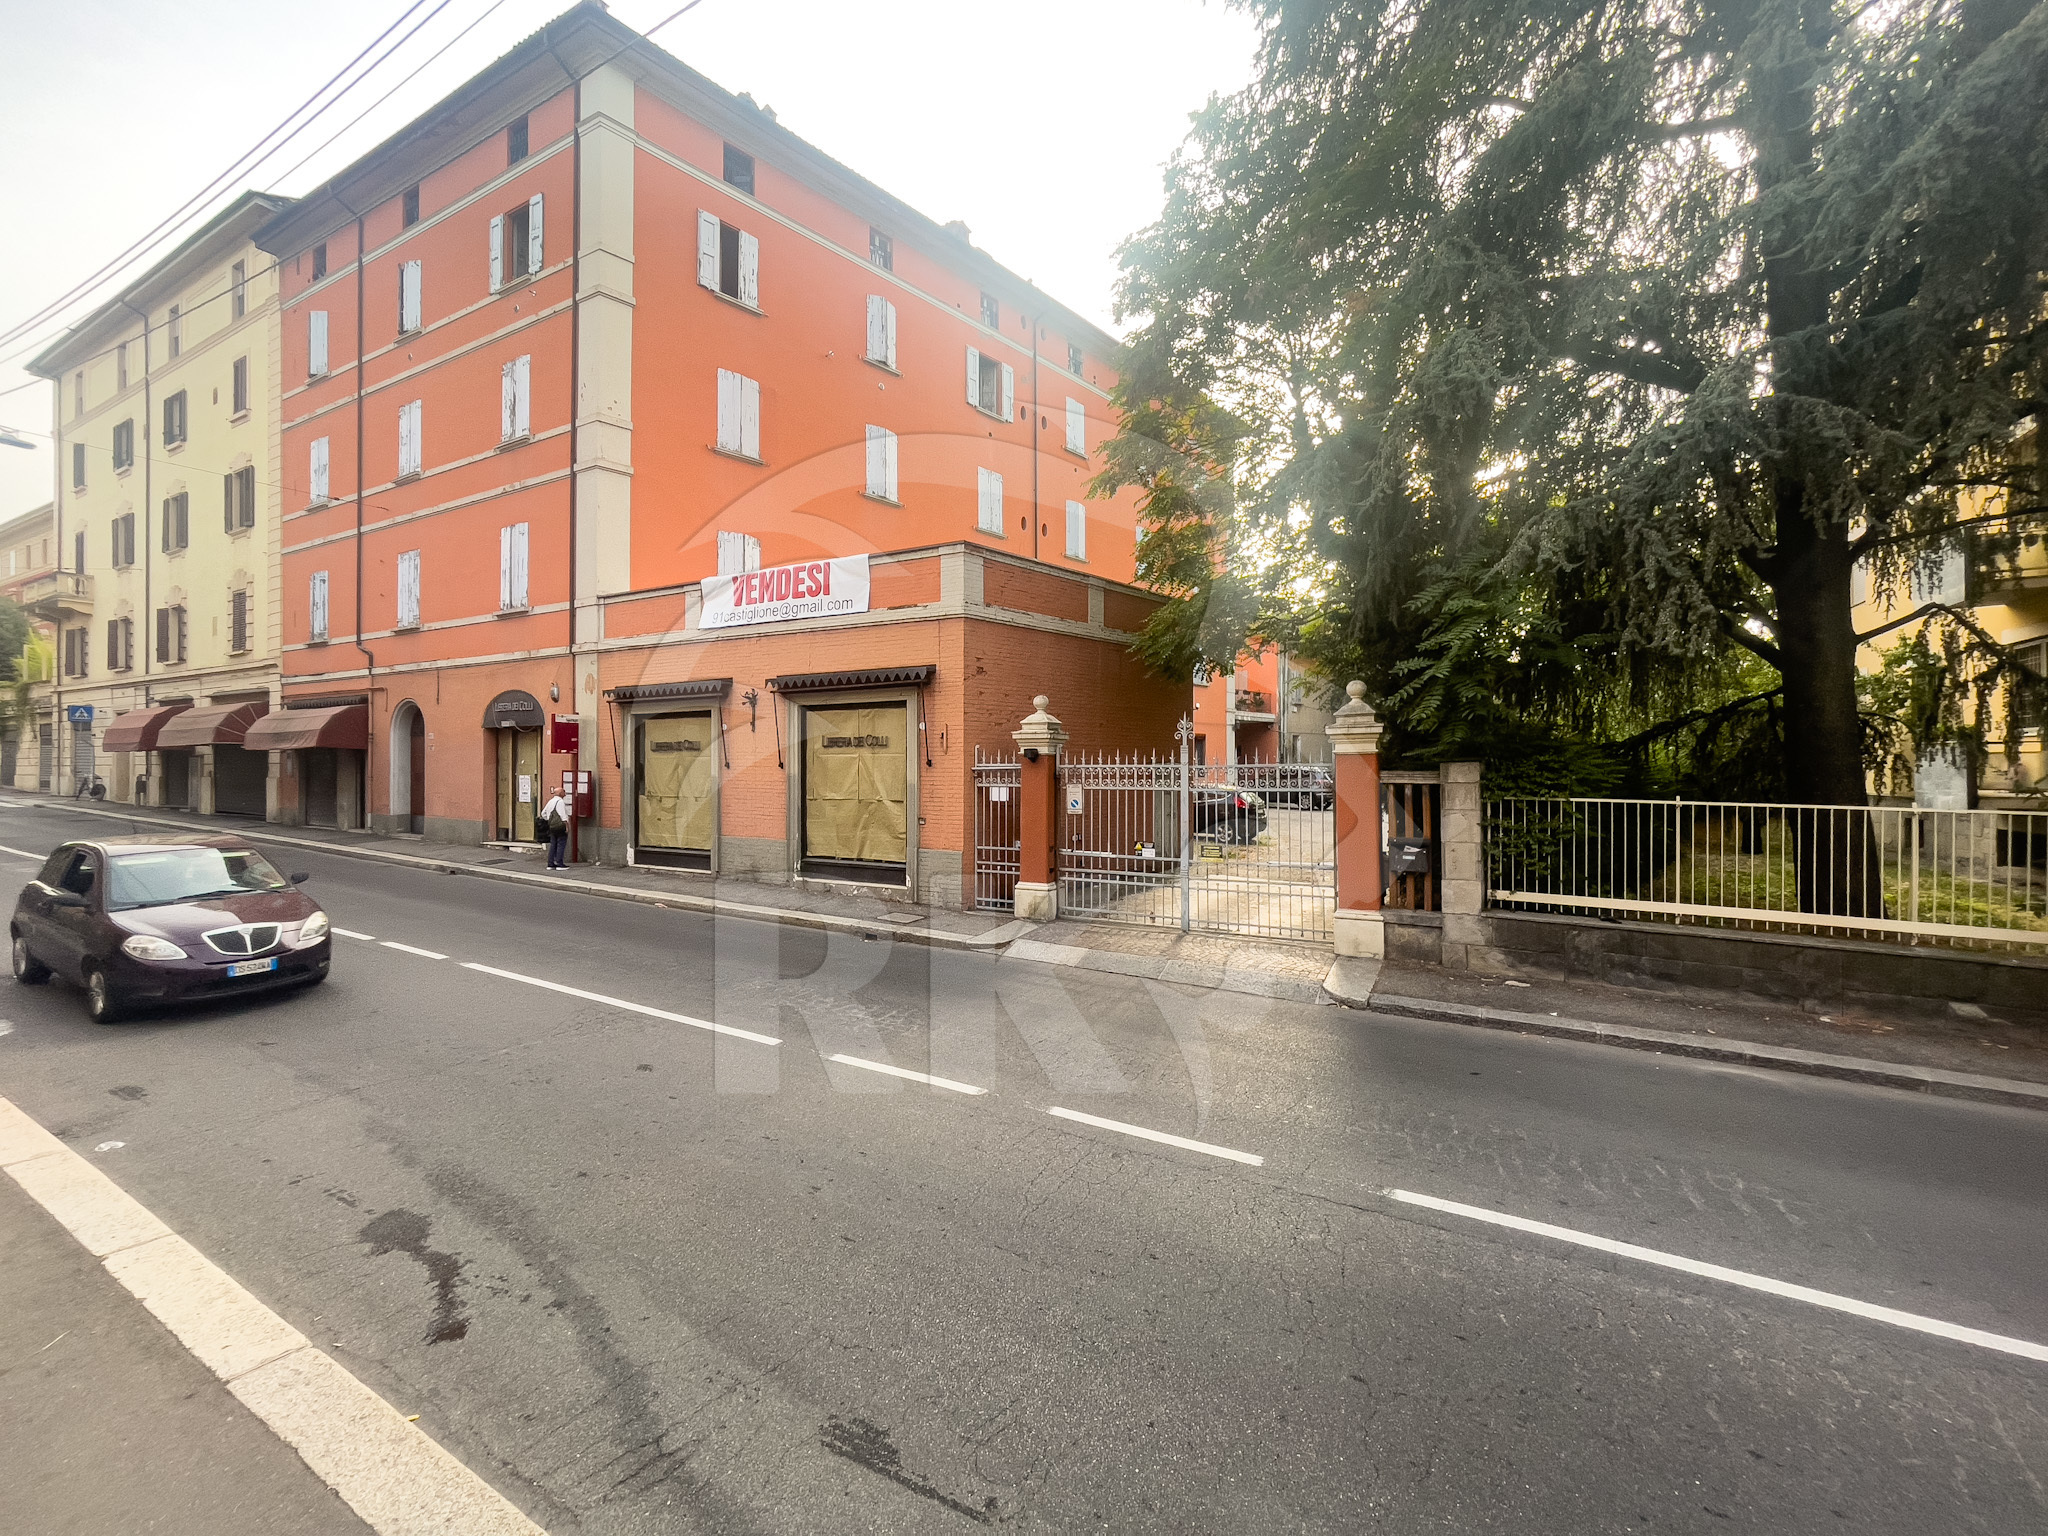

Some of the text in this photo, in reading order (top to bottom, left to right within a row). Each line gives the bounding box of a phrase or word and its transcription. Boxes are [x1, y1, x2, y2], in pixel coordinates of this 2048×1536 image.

[732, 561, 831, 607] VENDESI
[711, 597, 854, 624] 91castiglione@gmail.com
[866, 734, 888, 746] COLLI
